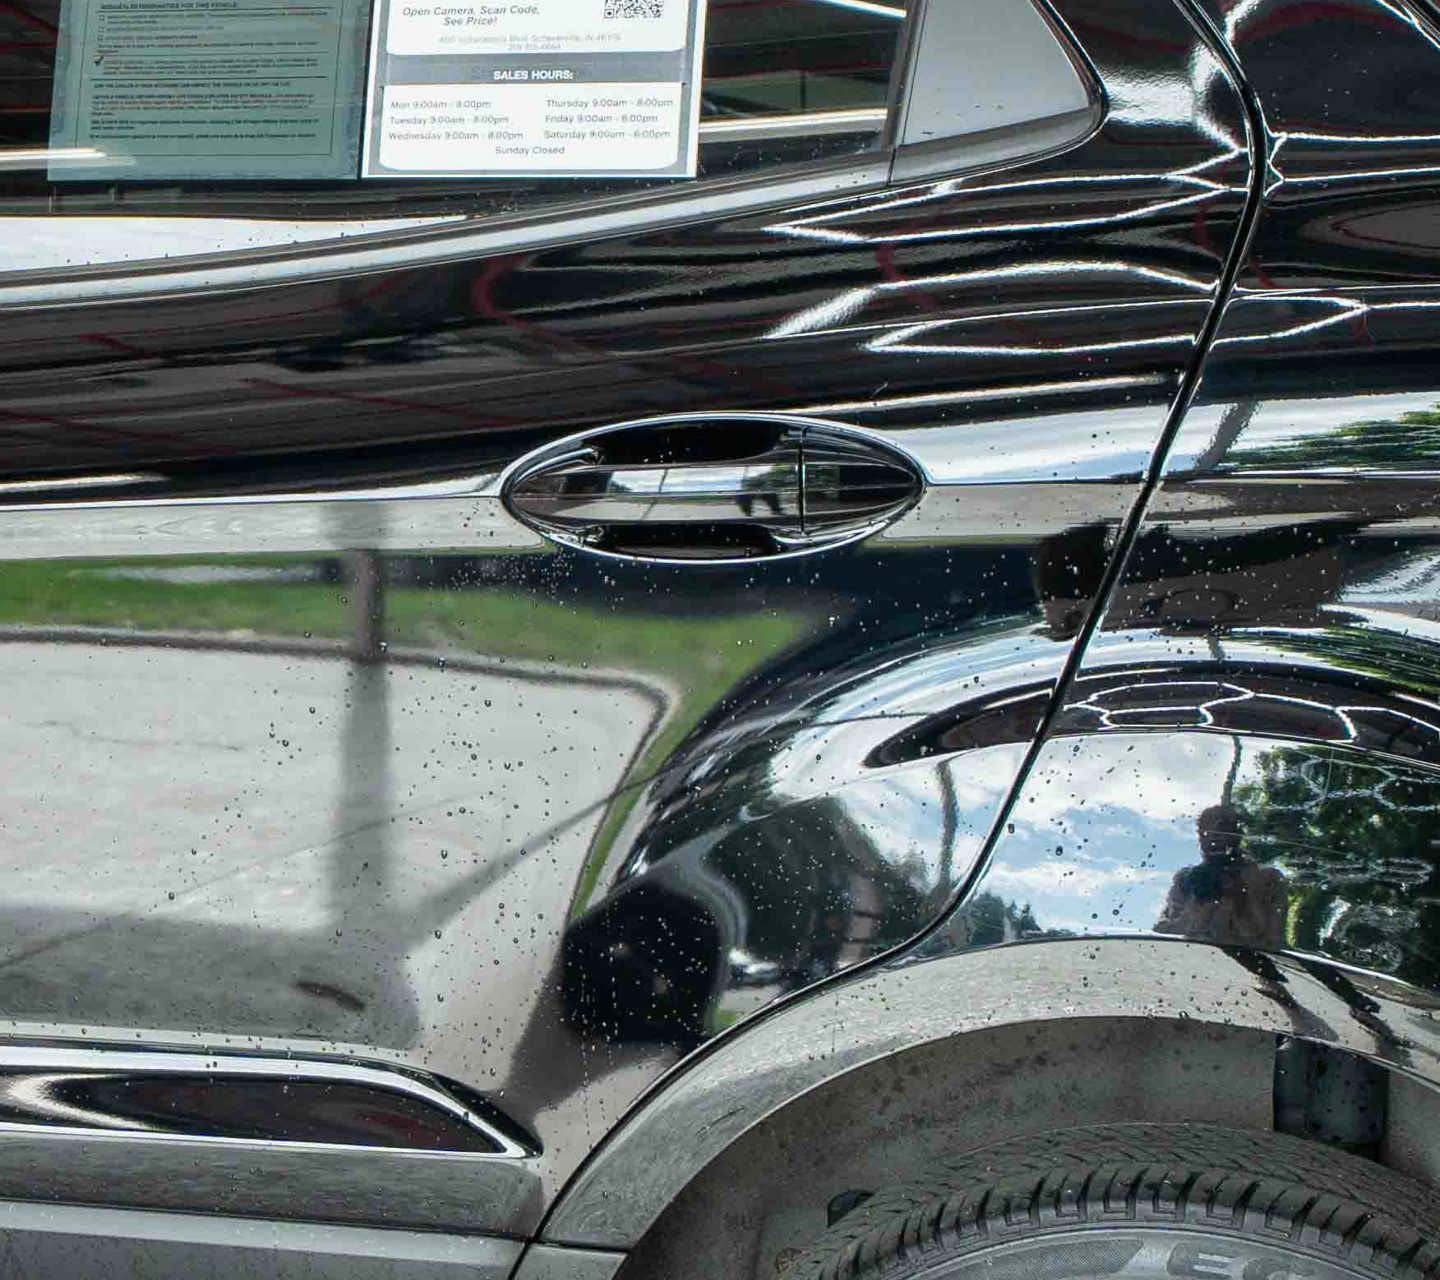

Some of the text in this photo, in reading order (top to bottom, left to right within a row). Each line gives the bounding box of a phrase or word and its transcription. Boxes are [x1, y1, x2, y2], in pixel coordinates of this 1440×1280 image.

[403, 6, 431, 17] Open
[480, 5, 506, 15] Scan
[443, 16, 498, 26] See Price!
[493, 69, 574, 81] SALES HOURS:
[390, 100, 411, 109] Mon
[547, 97, 589, 109] Thursday
[390, 115, 427, 126] Tuesday
[545, 113, 575, 125] Friday
[389, 130, 442, 141] Wednesday
[544, 129, 587, 140] Saturday
[495, 145, 565, 156] Sunday Closed
